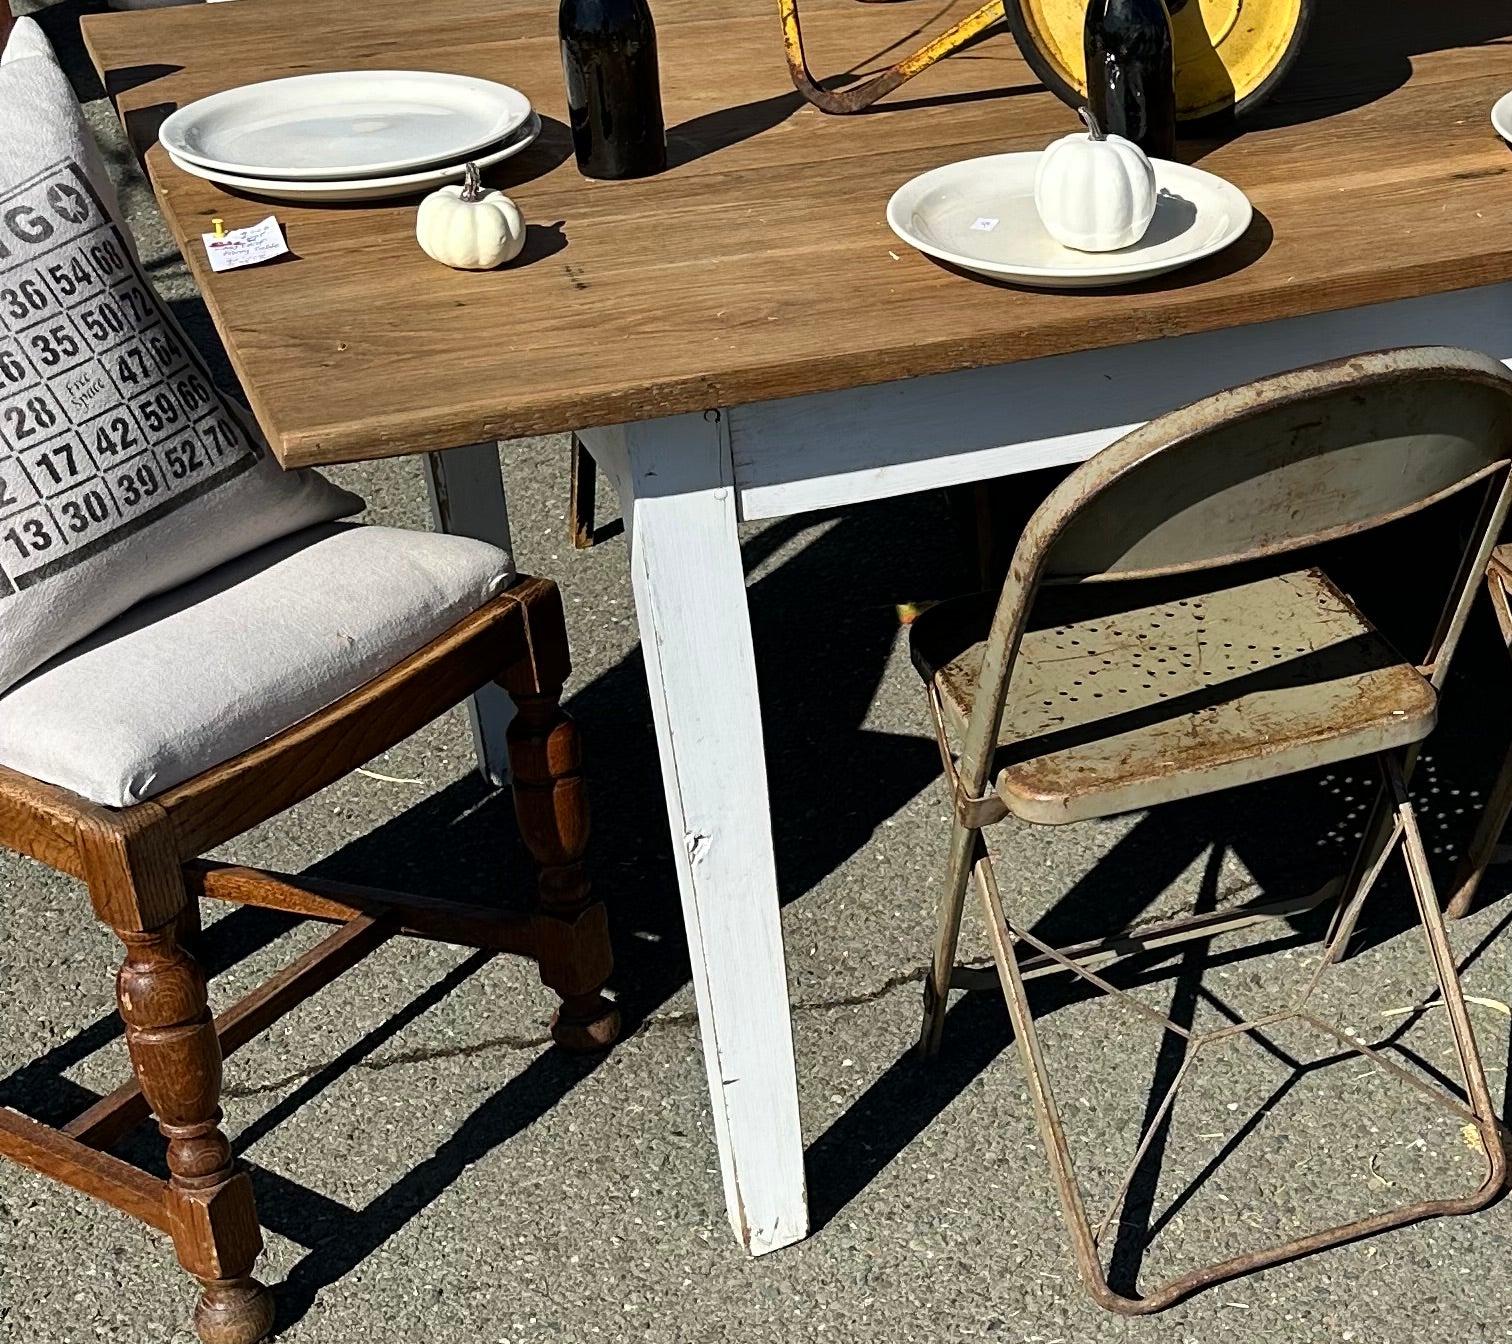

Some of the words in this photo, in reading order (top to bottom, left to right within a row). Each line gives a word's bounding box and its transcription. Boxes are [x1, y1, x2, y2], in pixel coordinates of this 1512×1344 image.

[0, 183, 89, 259] GO
[0, 279, 48, 320] 36
[48, 256, 93, 296] 54
[91, 239, 124, 275] 68
[0, 350, 26, 389] 6
[31, 325, 80, 366] 35
[81, 302, 125, 341] 50
[119, 287, 154, 323] 72
[4, 396, 57, 440] 28
[118, 346, 151, 385] 47
[150, 329, 183, 367] 64
[35, 443, 79, 484] 17
[96, 417, 137, 456] 42
[138, 392, 179, 433] 59
[177, 374, 210, 412] 66
[65, 372, 92, 396] Free
[71, 377, 105, 414] Space
[4, 518, 53, 558] 13
[62, 490, 109, 533] 30
[118, 464, 159, 506] 39
[165, 439, 204, 480] 52
[203, 418, 239, 457] 70
